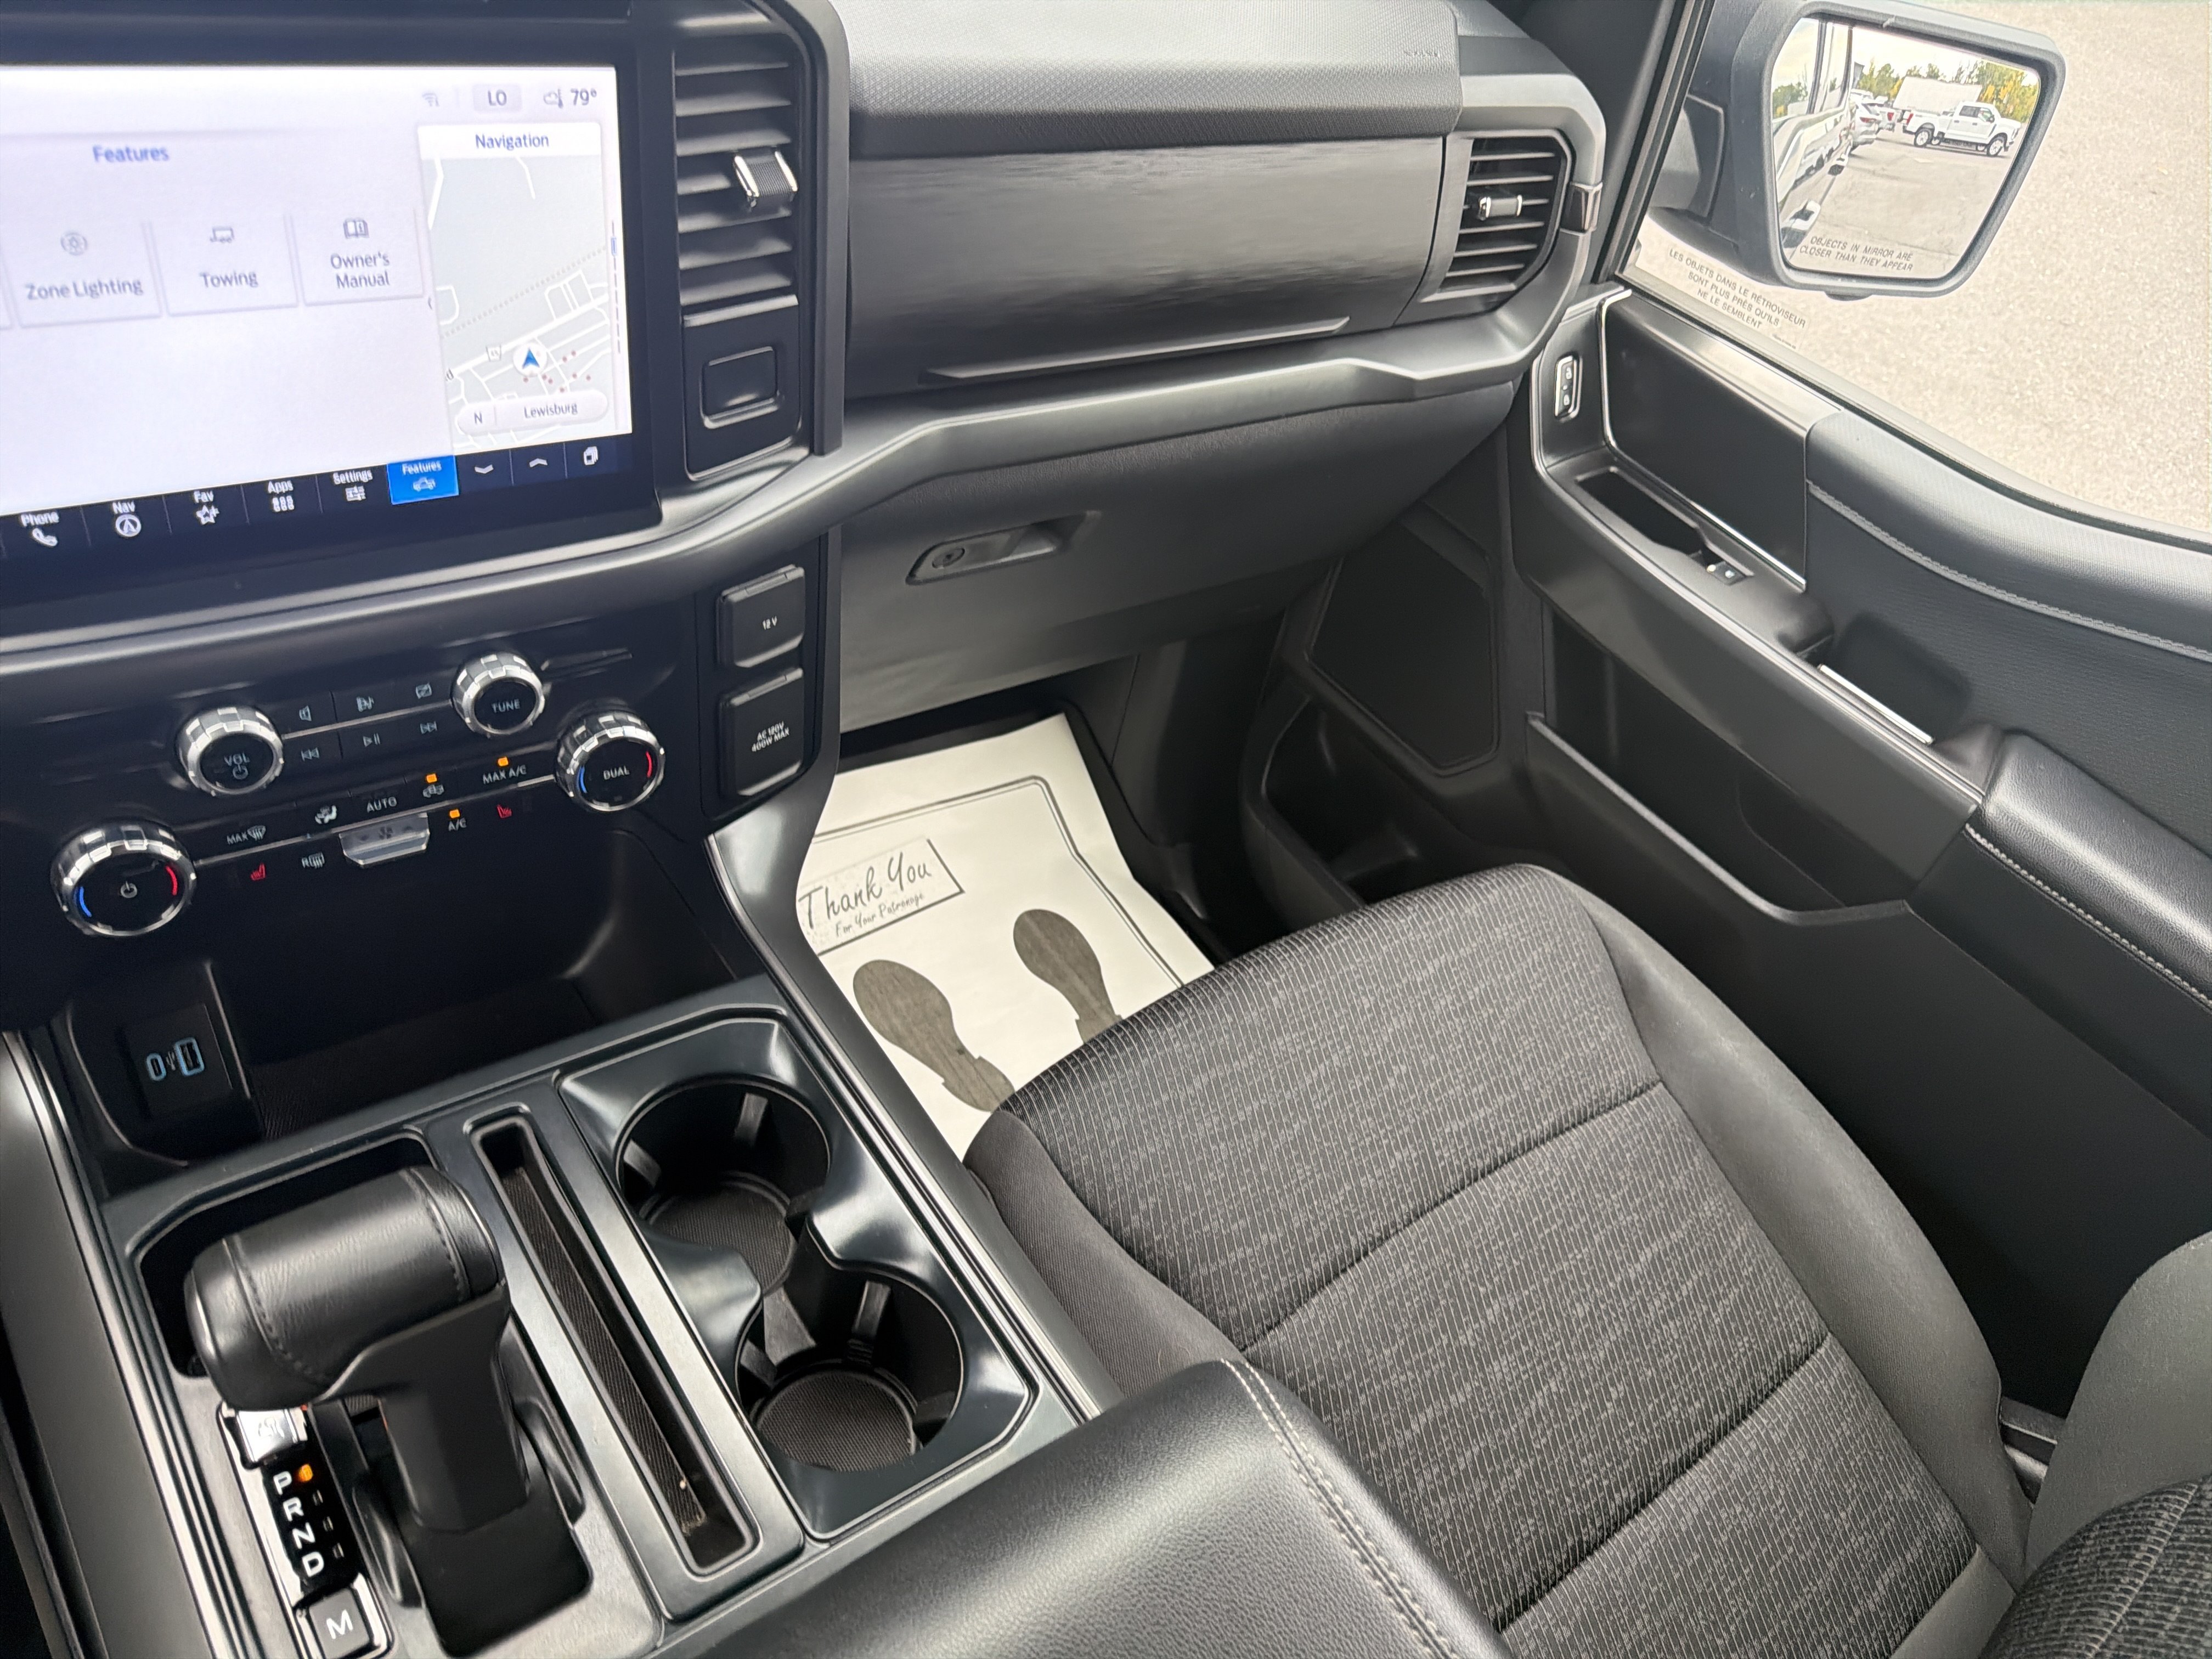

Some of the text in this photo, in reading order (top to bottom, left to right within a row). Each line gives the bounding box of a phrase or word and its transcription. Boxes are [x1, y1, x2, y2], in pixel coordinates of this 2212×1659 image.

[487, 90, 507, 106] LO
[570, 88, 597, 106] 79°
[475, 133, 549, 150] Navigation
[92, 144, 170, 163] Features
[1810, 235, 1913, 261] OBJECTS IN MIRROR ARE
[330, 251, 390, 269] Owner's
[1799, 245, 1914, 272] CLOSER THAN THEY APPEAR
[199, 270, 258, 289] Towing
[336, 272, 391, 289] Manual
[1669, 249, 1683, 262] LES
[1685, 257, 1714, 279] OBJETS
[1716, 276, 1737, 290] DANS
[1739, 286, 1749, 297] LE
[26, 279, 144, 300] Zone Lighting
[1688, 272, 1709, 287] SONT
[1711, 284, 1729, 300] PLUS
[1754, 308, 1780, 326] QU'ILS
[1697, 289, 1762, 329] NE LE SEMBLENT
[474, 411, 482, 424] N
[524, 403, 578, 419] Lewisburg
[402, 460, 442, 476] Features
[333, 469, 373, 486] Settings
[267, 479, 294, 494] Apps
[193, 490, 214, 504] Fav
[112, 500, 136, 514] Nav
[20, 511, 59, 527] Phone
[492, 699, 521, 713] TUNE
[774, 727, 789, 742] MAX
[224, 752, 250, 766] VOL
[483, 765, 527, 785] MAX A/C
[603, 766, 630, 781] DUAL
[367, 797, 397, 812] AUTO
[448, 817, 467, 831] A/C
[227, 832, 249, 845] MAX
[798, 851, 932, 929] Thank You
[836, 893, 924, 938] For Your Patronage
[274, 1471, 292, 1496] P
[283, 1497, 303, 1522] R
[292, 1522, 315, 1549] N
[302, 1551, 324, 1577] D
[326, 1609, 353, 1639] M
